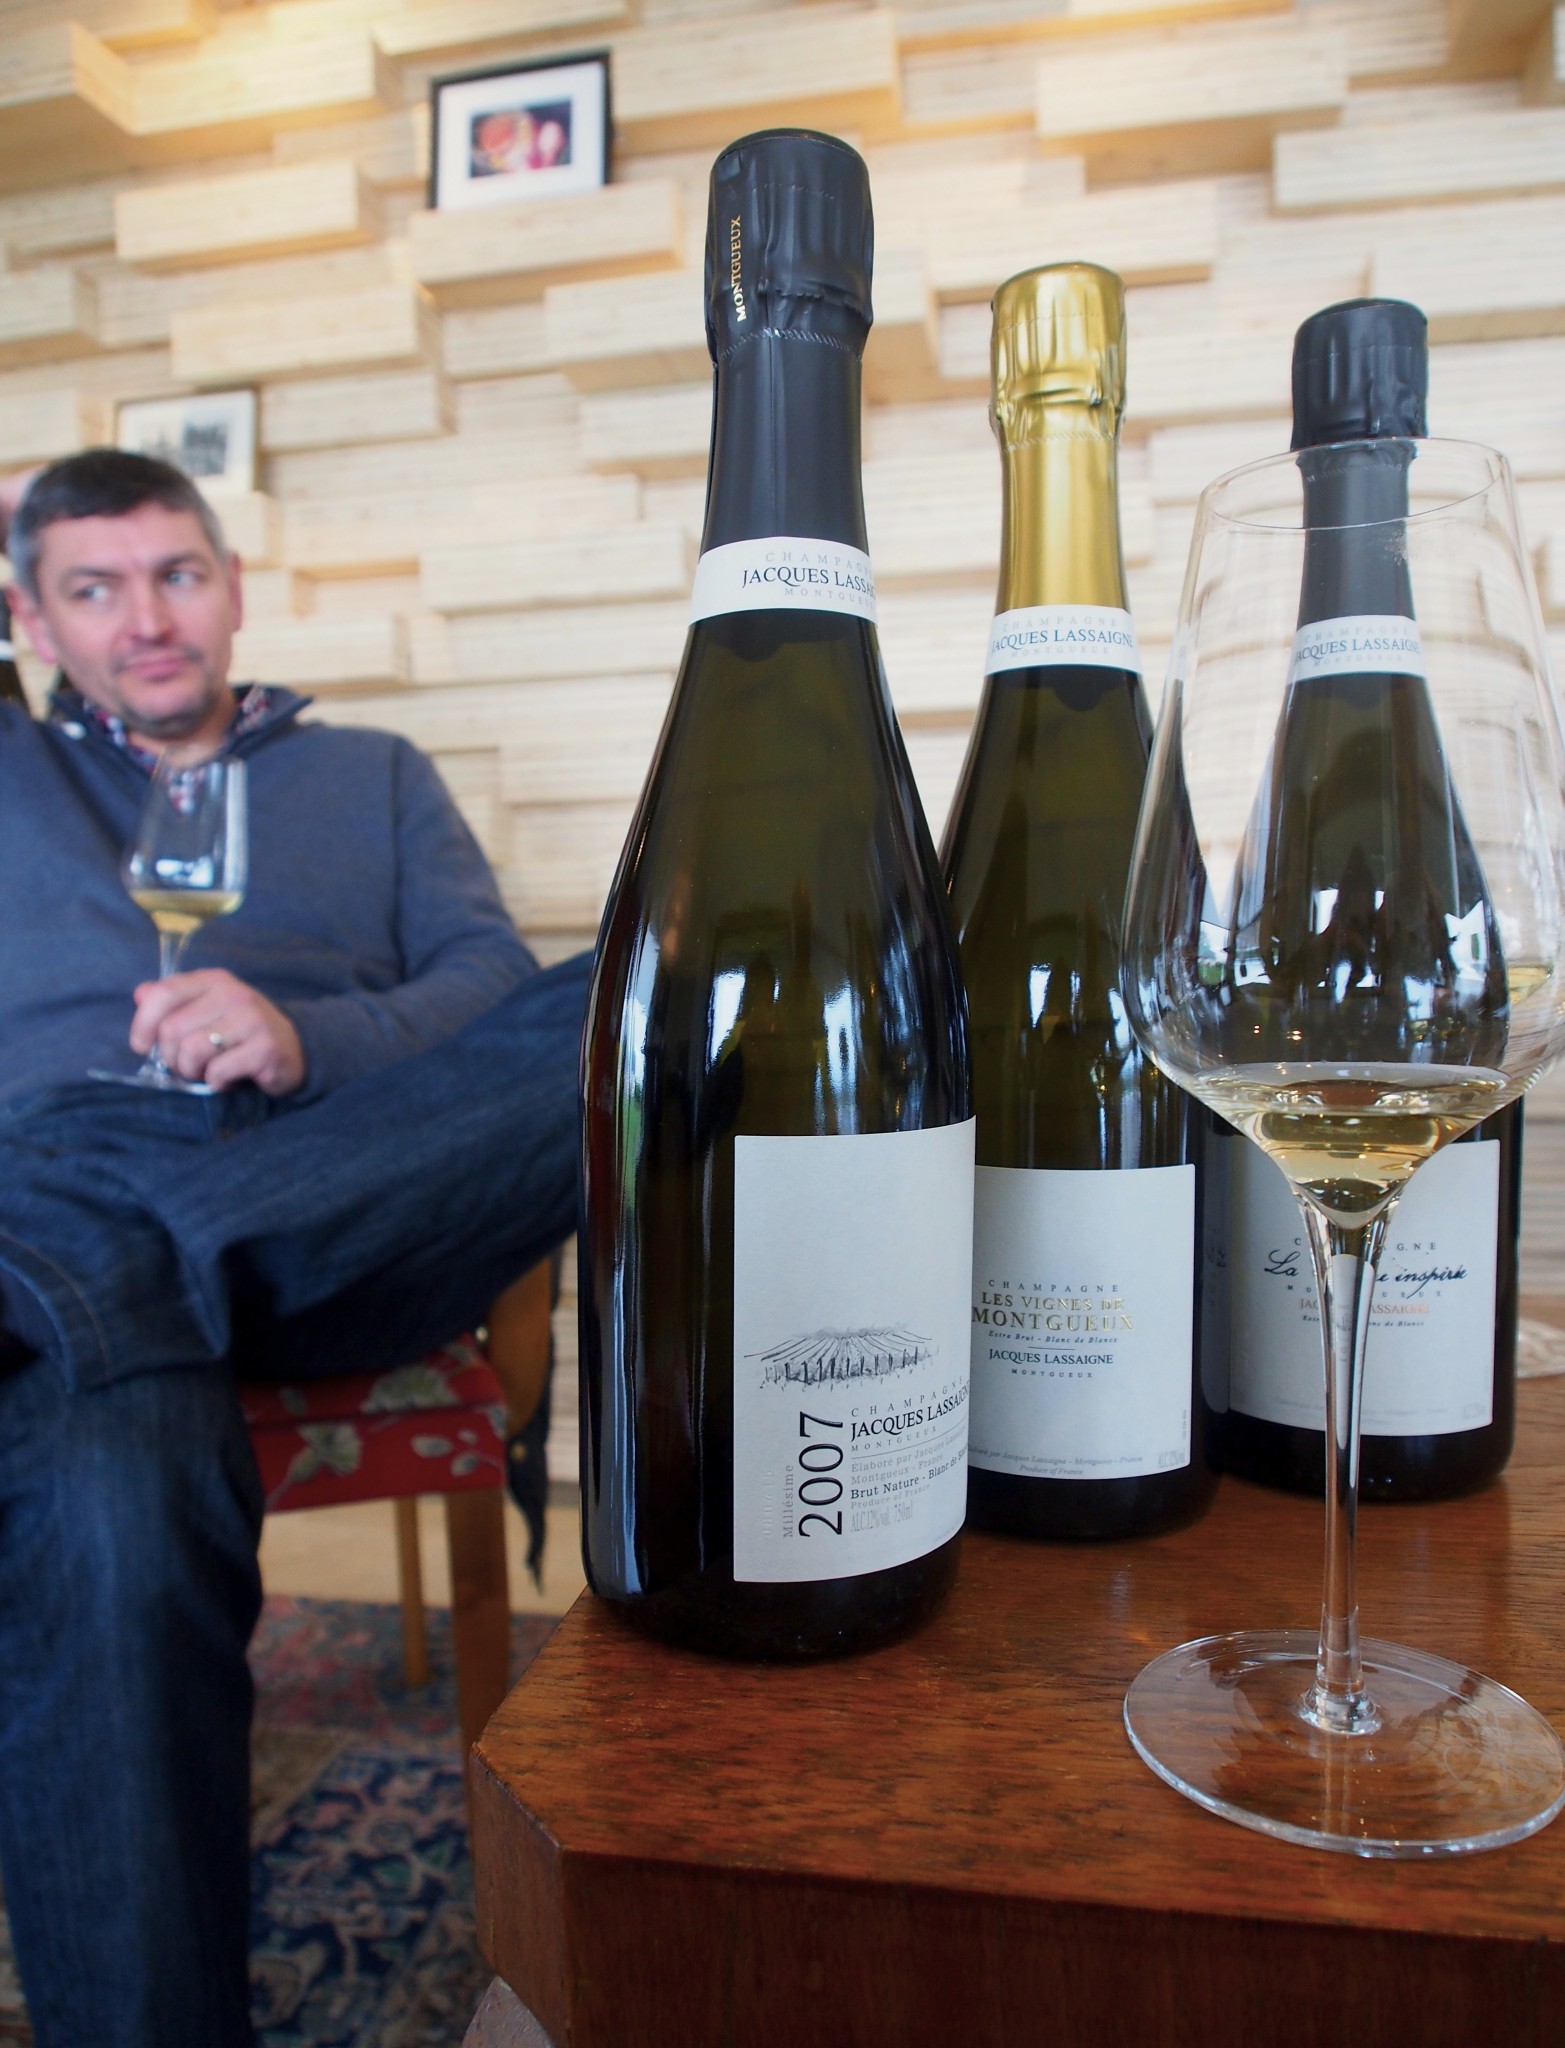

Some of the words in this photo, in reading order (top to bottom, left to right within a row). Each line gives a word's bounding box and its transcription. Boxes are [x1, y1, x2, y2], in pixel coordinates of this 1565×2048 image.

[731, 215, 747, 322] MONTGUEUX
[742, 566, 829, 588] JACQUES
[1002, 616, 1118, 632] CHAMPAGNE
[991, 630, 1048, 655] JACQUES
[1054, 629, 1134, 648] LASSAIGNE
[1264, 1248, 1301, 1277] La
[988, 1279, 1119, 1293] CHAMPAGNE
[982, 1292, 1014, 1307] LES
[1022, 1296, 1092, 1311] VIGNES
[1101, 1297, 1125, 1311] DE
[971, 1306, 1136, 1332] MONTGUEUX
[988, 1330, 1011, 1339] Extra
[1015, 1333, 1034, 1341] Brut
[1045, 1335, 1071, 1344] Blanc
[1074, 1336, 1084, 1344] de
[1088, 1336, 1118, 1344] Blancs
[989, 1348, 1041, 1365] JACQUES
[1044, 1354, 1114, 1365] LASSAIGNE
[1011, 1368, 1093, 1378] MONTGUEUX
[851, 1376, 963, 1417] CHAMPAGNE
[851, 1409, 923, 1442] JACQUES
[851, 1426, 937, 1453] MONTGUEUX
[896, 1454, 912, 1470] par
[914, 1441, 945, 1459] Jacques
[799, 1411, 843, 1537] 2007
[851, 1466, 909, 1485] Montgueux
[851, 1486, 879, 1499] Brut
[883, 1476, 920, 1494] Nature
[928, 1462, 949, 1480] Blanc
[783, 1465, 793, 1538] Millésime
[851, 1497, 890, 1509] Produce
[904, 1483, 930, 1498] France
